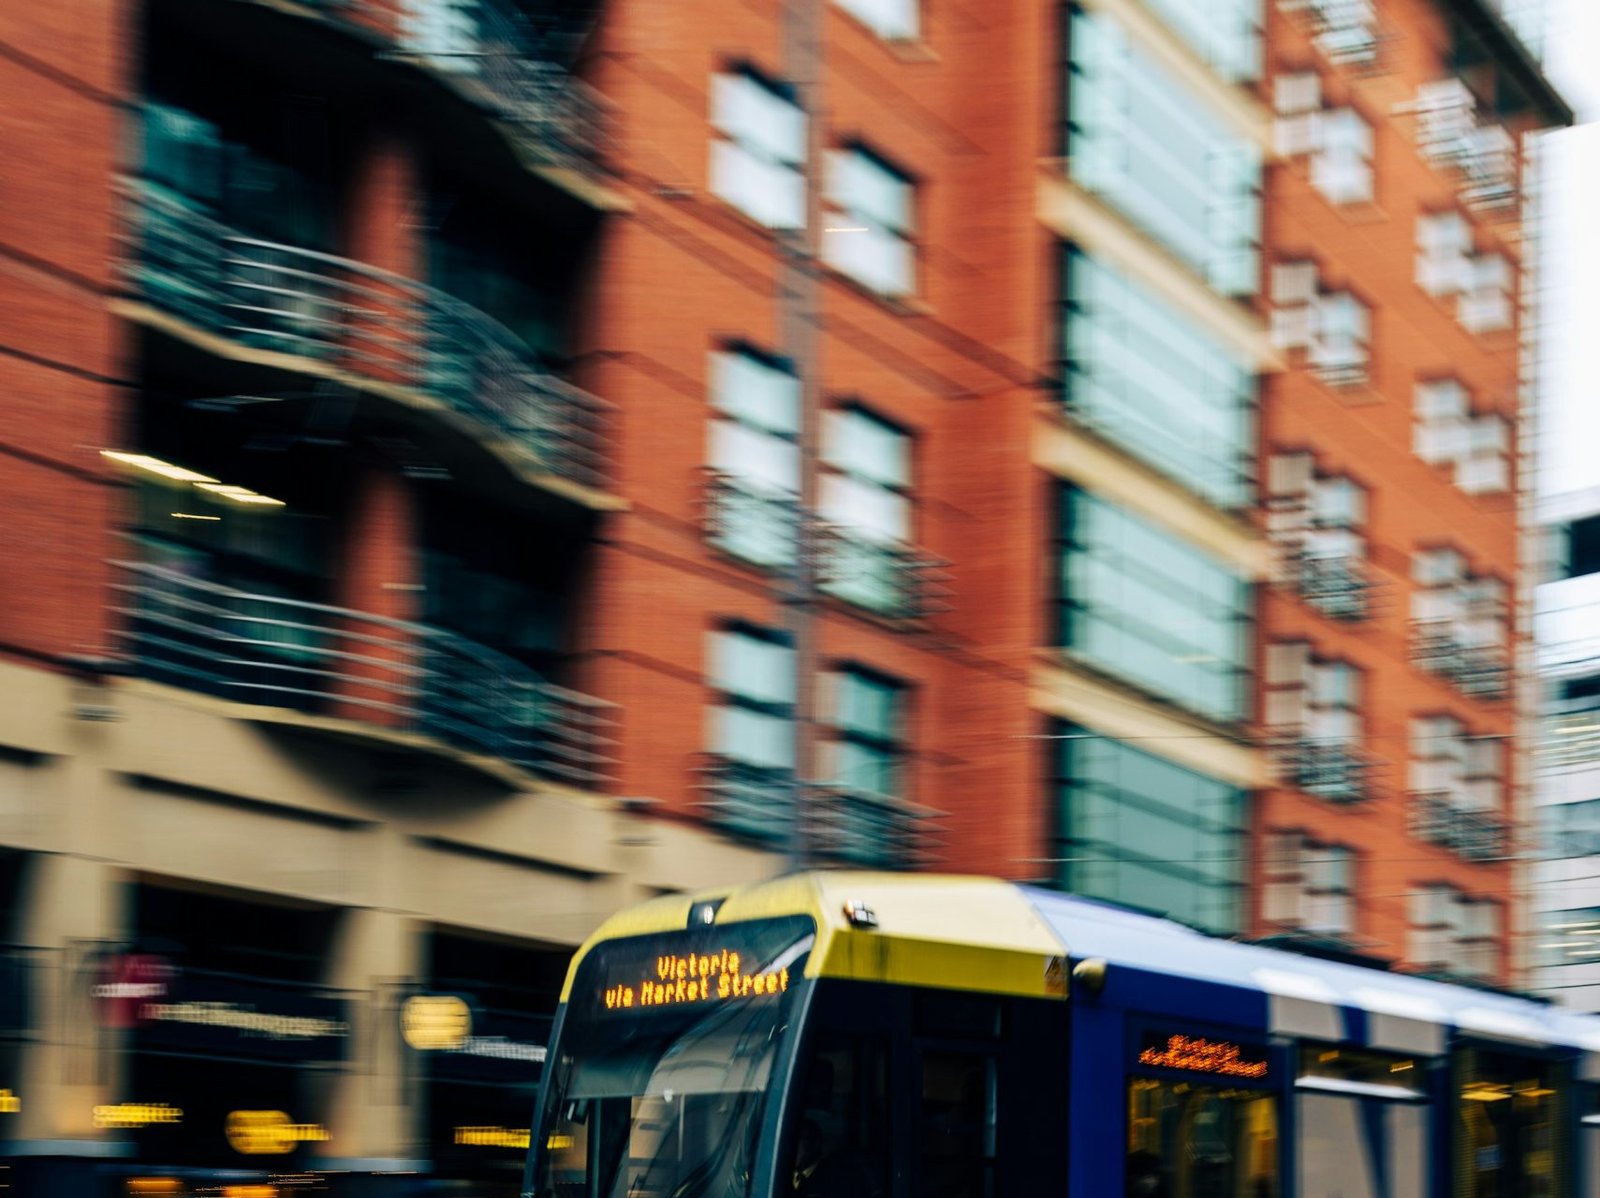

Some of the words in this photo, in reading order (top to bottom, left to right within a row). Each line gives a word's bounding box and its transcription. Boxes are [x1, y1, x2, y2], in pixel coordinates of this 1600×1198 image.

[657, 949, 740, 980] Victoria
[606, 984, 633, 1008] via
[641, 975, 709, 1005] Market
[717, 966, 789, 998] Street
